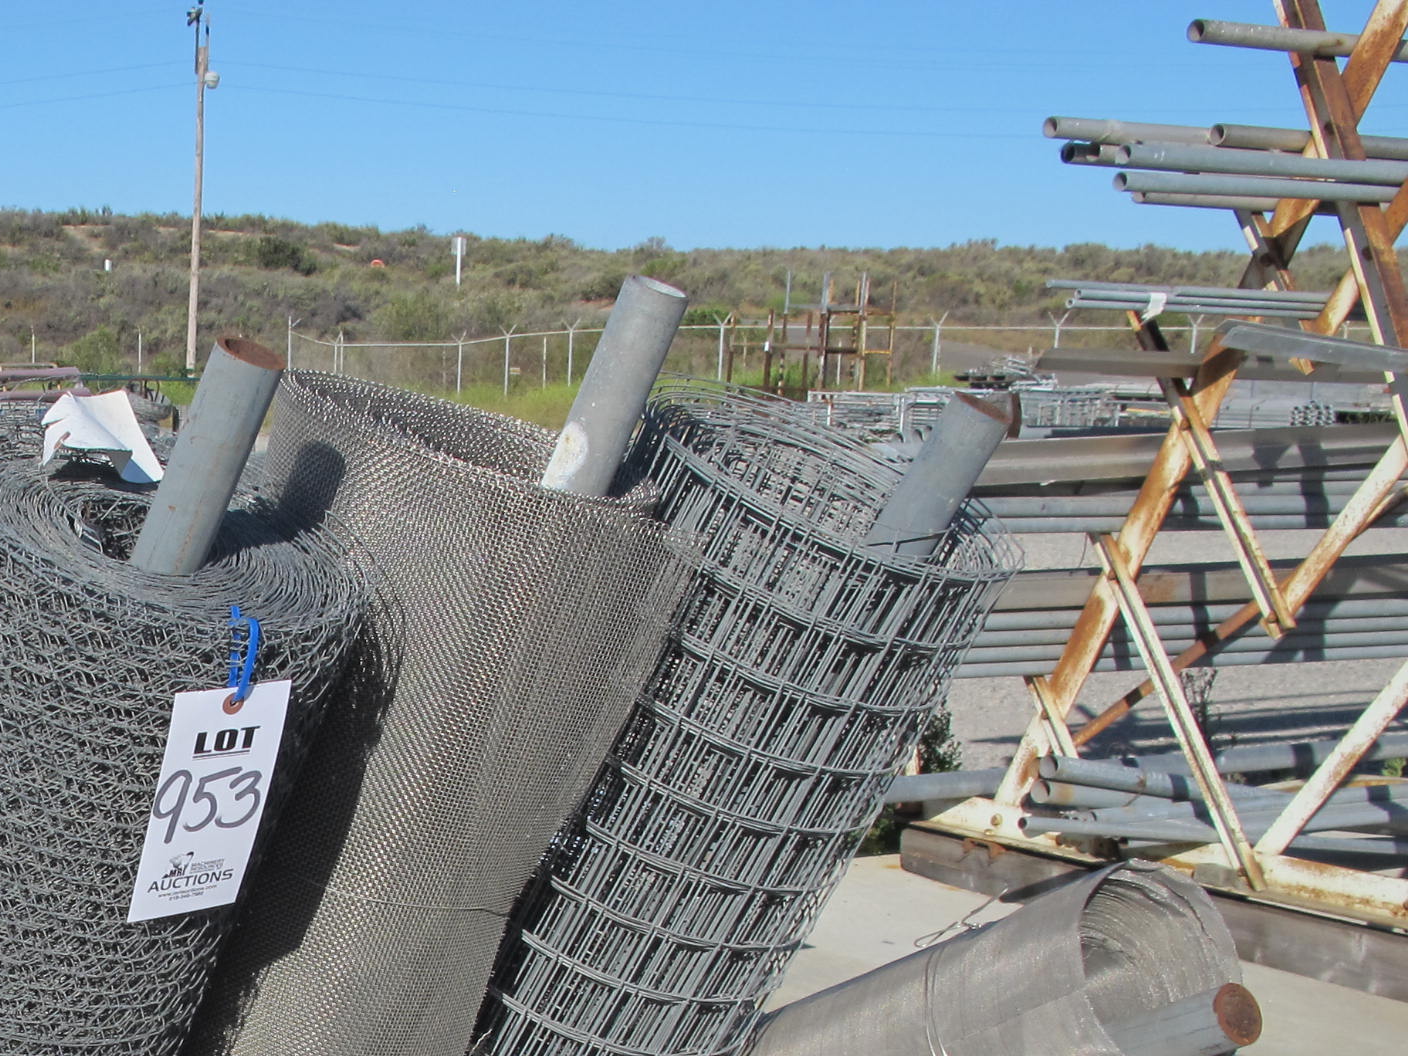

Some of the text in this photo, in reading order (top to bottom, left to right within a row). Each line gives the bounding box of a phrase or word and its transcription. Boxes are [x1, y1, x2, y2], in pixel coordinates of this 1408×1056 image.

[193, 725, 261, 756] LOT
[152, 766, 263, 844] 953
[147, 868, 234, 893] AUCTIONS
